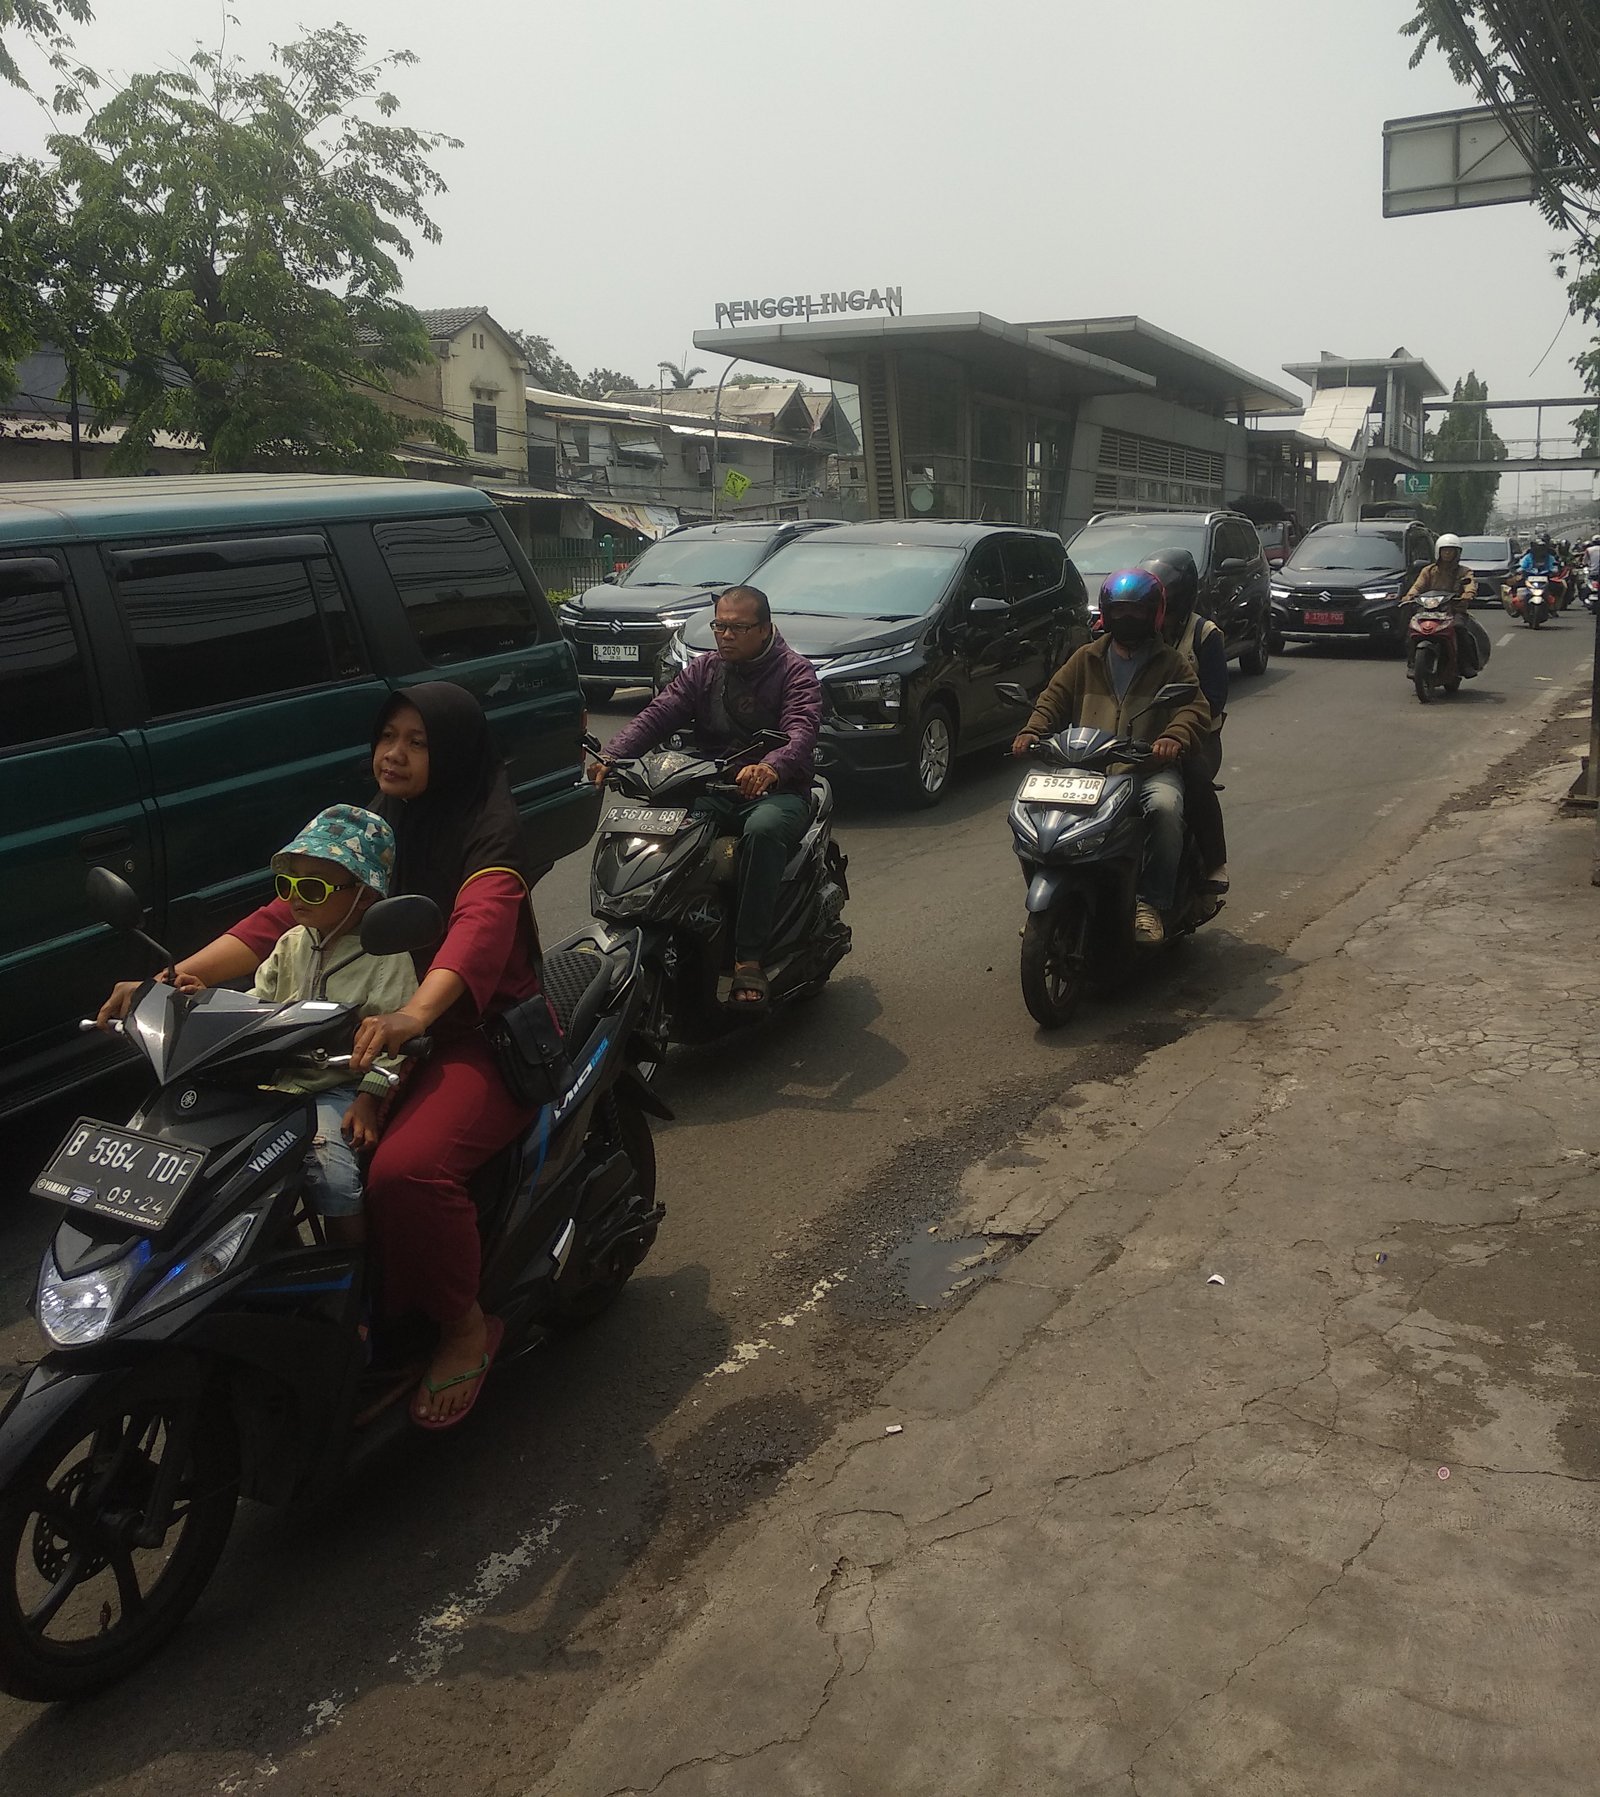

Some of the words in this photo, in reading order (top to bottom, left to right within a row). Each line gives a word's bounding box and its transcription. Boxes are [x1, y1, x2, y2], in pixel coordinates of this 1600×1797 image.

[715, 286, 902, 323] PENGGILINGAN
[594, 646, 599, 656] B
[602, 646, 620, 656] 2039
[624, 647, 637, 656] TIZ
[1028, 777, 1037, 788] B
[1043, 778, 1074, 788] 5945
[1079, 779, 1100, 790] TUR
[608, 808, 617, 819] B
[66, 1131, 89, 1157] B
[88, 1136, 144, 1173] 5964
[146, 1152, 192, 1185] TDF
[249, 1130, 297, 1173] YAMAHA
[41, 1179, 71, 1197] YAMAHA
